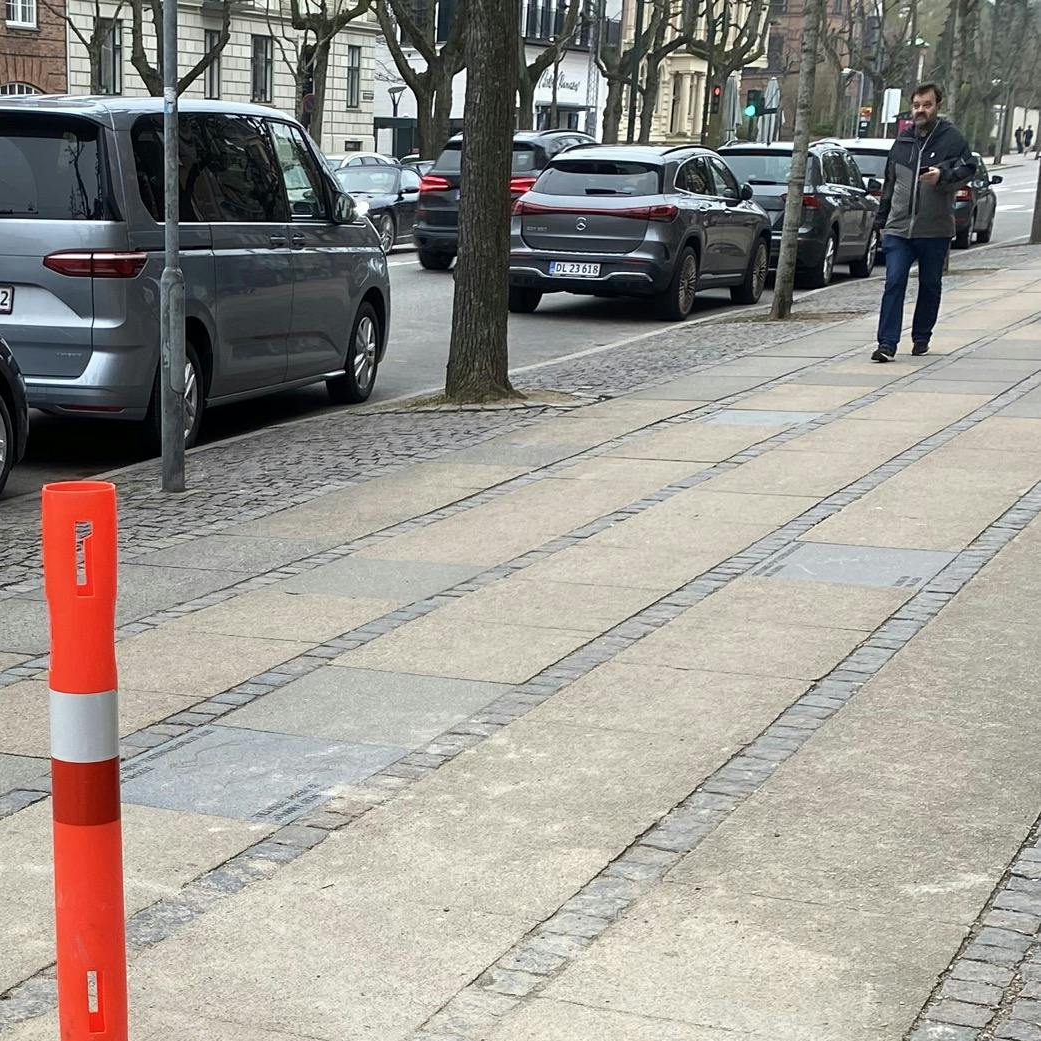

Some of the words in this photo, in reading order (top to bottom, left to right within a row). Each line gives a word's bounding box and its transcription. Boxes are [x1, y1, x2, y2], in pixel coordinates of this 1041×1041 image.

[555, 263, 567, 273] DL
[569, 263, 581, 273] 23
[581, 264, 599, 275] 618
